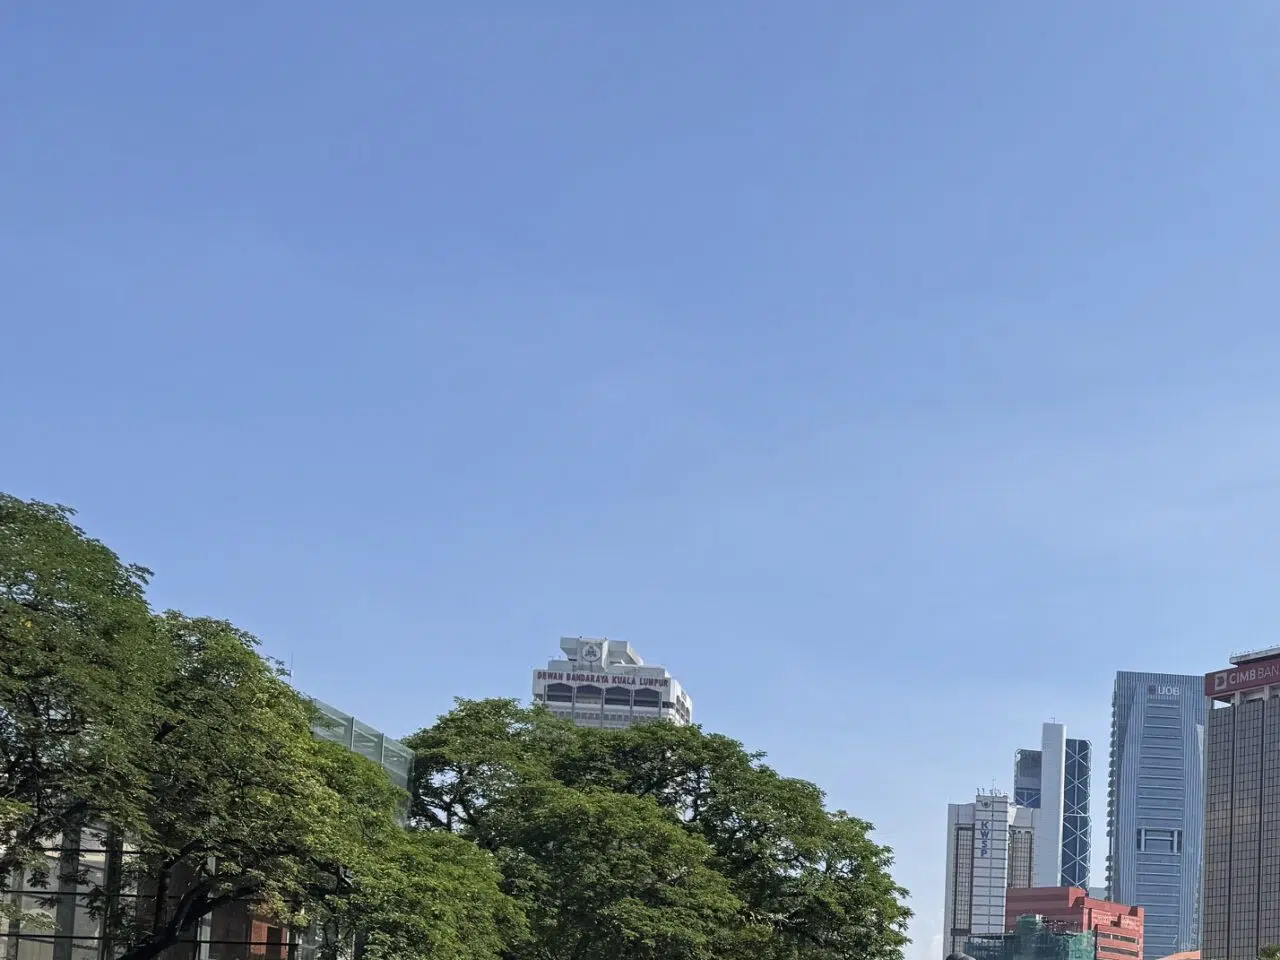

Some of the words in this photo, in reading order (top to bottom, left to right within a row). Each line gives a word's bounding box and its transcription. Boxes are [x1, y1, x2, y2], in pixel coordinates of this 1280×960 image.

[537, 671, 563, 681] DEWAN
[566, 673, 609, 684] BANDARAYA
[612, 676, 637, 685] KUALA
[639, 677, 668, 687] LUMPUR
[1229, 669, 1256, 685] CIMB
[1158, 685, 1180, 695] UOB
[980, 821, 990, 857] KWSP
